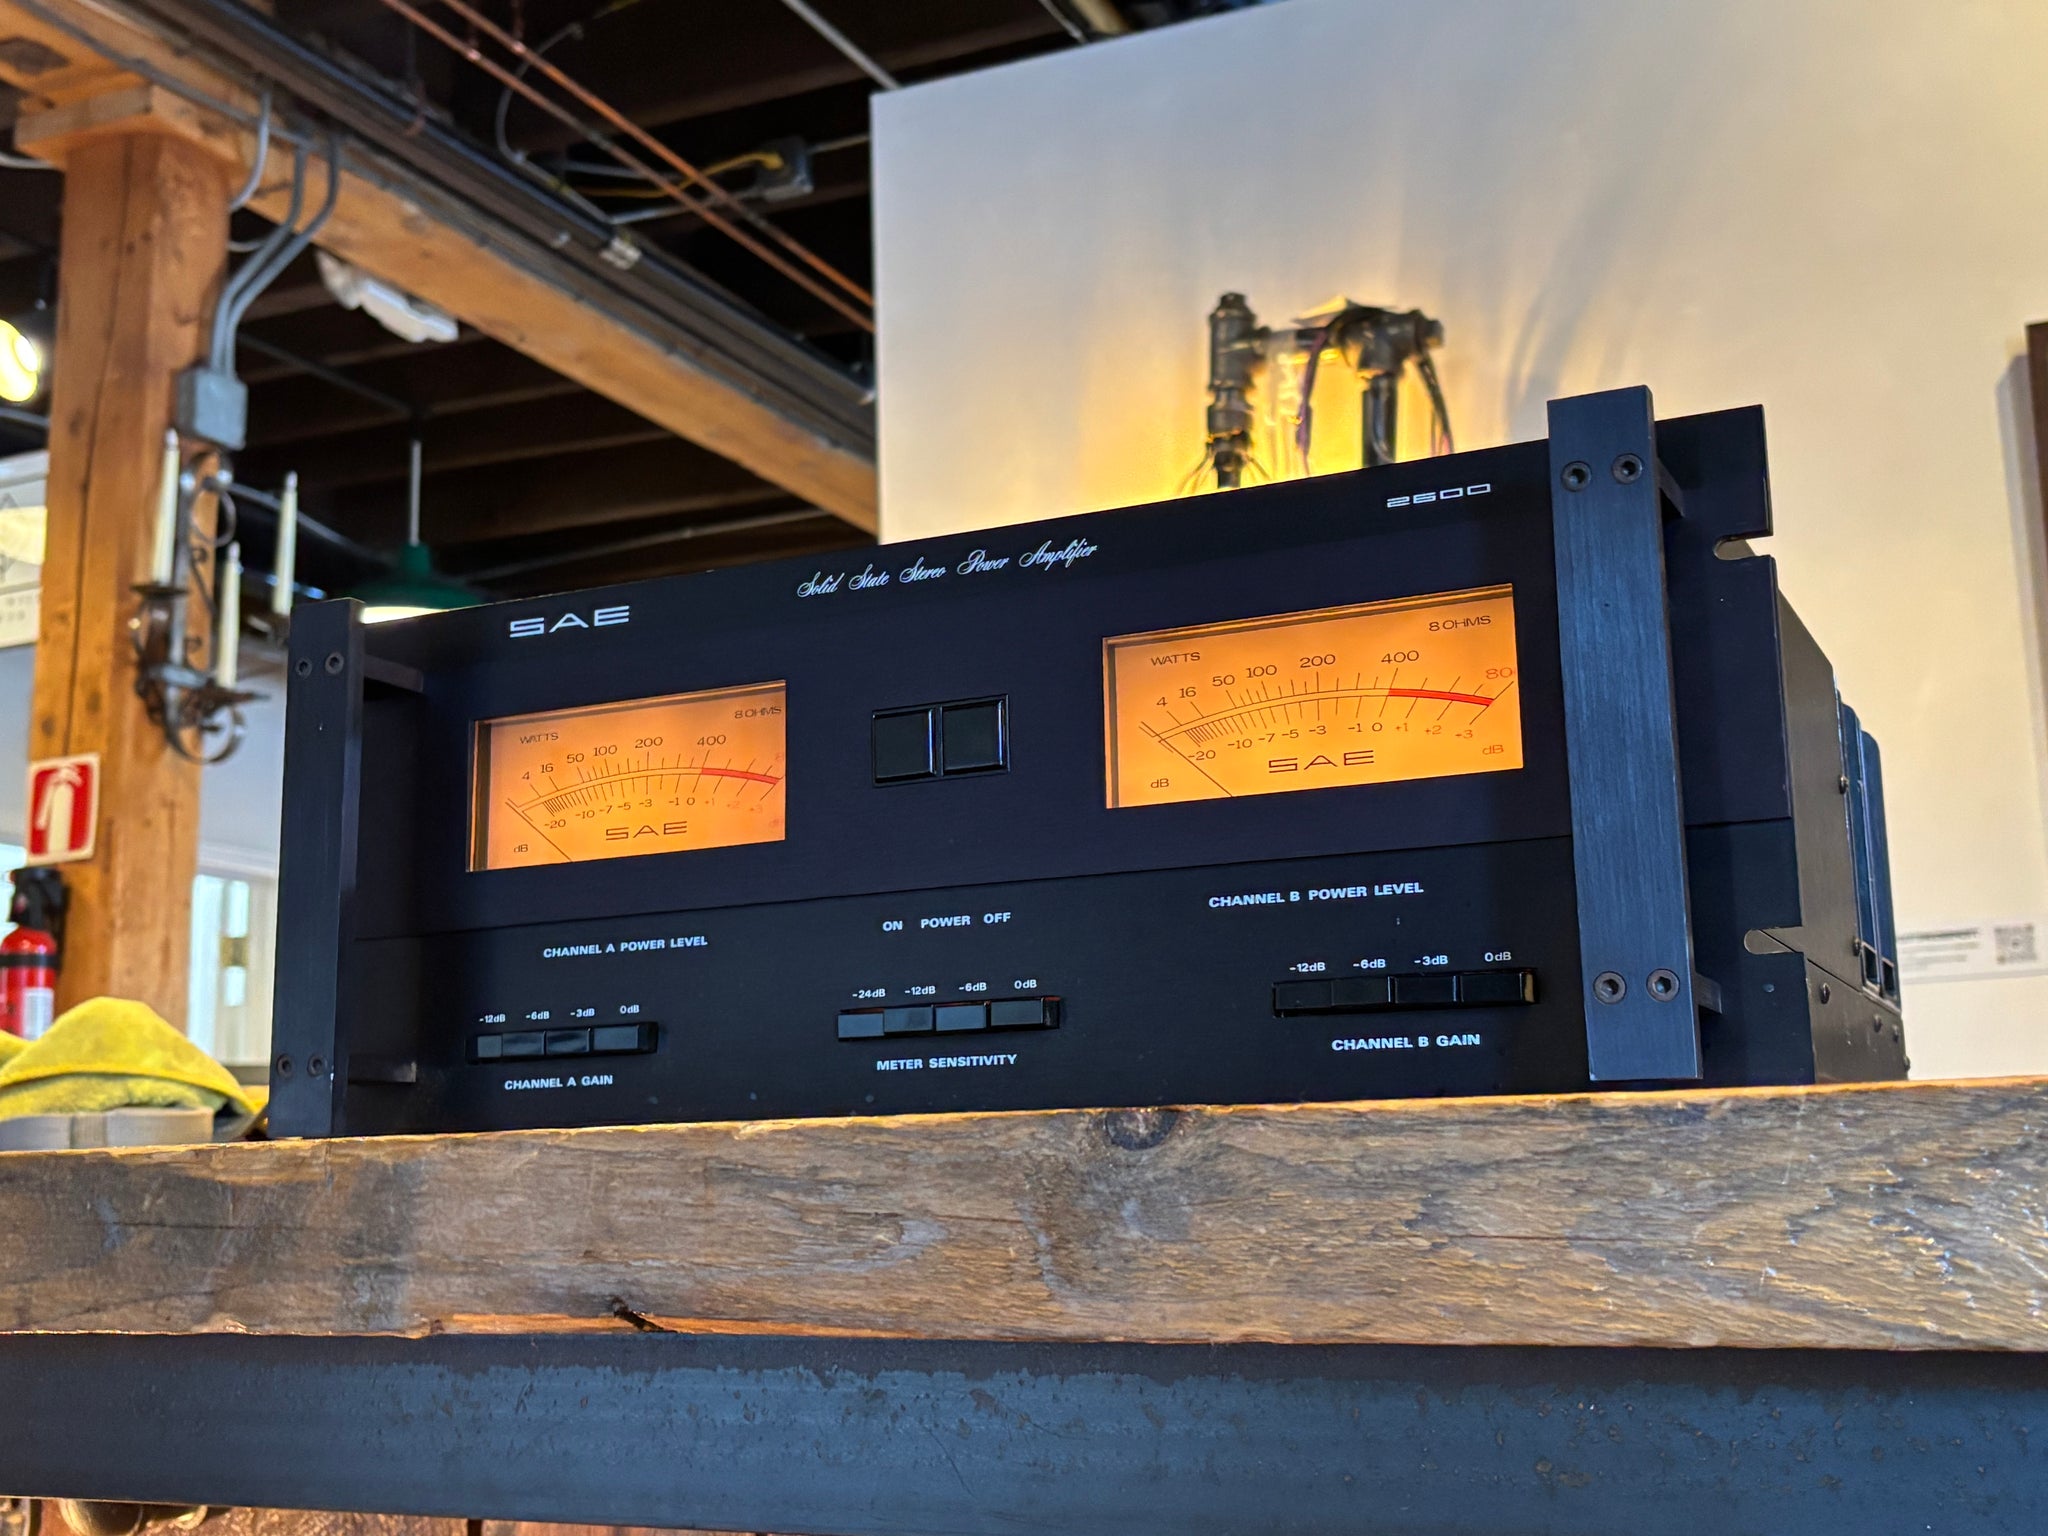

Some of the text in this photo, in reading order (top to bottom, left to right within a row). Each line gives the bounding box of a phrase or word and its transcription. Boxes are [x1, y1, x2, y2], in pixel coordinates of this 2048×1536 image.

[1386, 483, 1491, 508] 2600
[797, 538, 1098, 598] Solid State Stereo Power Amplifier
[509, 605, 630, 638] SAE
[1428, 615, 1492, 632] 8 OHMS
[1150, 651, 1201, 666] WATTS
[1156, 650, 1516, 707] 4 16 50 100 200 400 80
[520, 732, 559, 745] WATTS
[1187, 749, 1217, 761] -20
[1227, 738, 1253, 750] -10
[1258, 733, 1276, 743] -7
[1281, 728, 1299, 739] -5
[1308, 725, 1327, 735] -3
[1347, 723, 1363, 733] -1
[1371, 722, 1383, 732] 0
[522, 734, 727, 781] 4 16 50 100 200 400
[1482, 744, 1504, 756] dB
[1268, 750, 1375, 774] SAE
[1150, 778, 1170, 789] dB
[544, 818, 567, 829] -20
[575, 809, 595, 820] -10
[599, 804, 613, 814] -7
[617, 801, 631, 811] -5
[638, 798, 653, 808] -3
[686, 796, 696, 806] 0
[606, 820, 688, 841] SAE
[513, 843, 529, 853] dB
[1208, 881, 1424, 909] CHANNEL B POWER LEVEL
[882, 911, 1012, 932] ON POWER OFF
[543, 935, 708, 958] CHANNEL A POWER LEVEL
[1352, 958, 1386, 969] -6dB
[1414, 954, 1449, 966] -3dB
[1484, 951, 1512, 962] 0dB
[1289, 961, 1326, 973] -12dB
[904, 985, 937, 996] -12dB
[958, 981, 988, 993] -6dB
[1014, 979, 1038, 990] 0dB
[852, 987, 887, 999] -24dB
[526, 1010, 550, 1021] -6dB
[570, 1007, 596, 1018] -3dB
[619, 1004, 641, 1015] 0dB
[479, 1013, 506, 1024] -12dB
[1331, 1033, 1481, 1051] CHANNEL B GAIN
[876, 1054, 1018, 1071] METER SENSITIVITY
[504, 1075, 614, 1091] CHANNEL A GAIN
